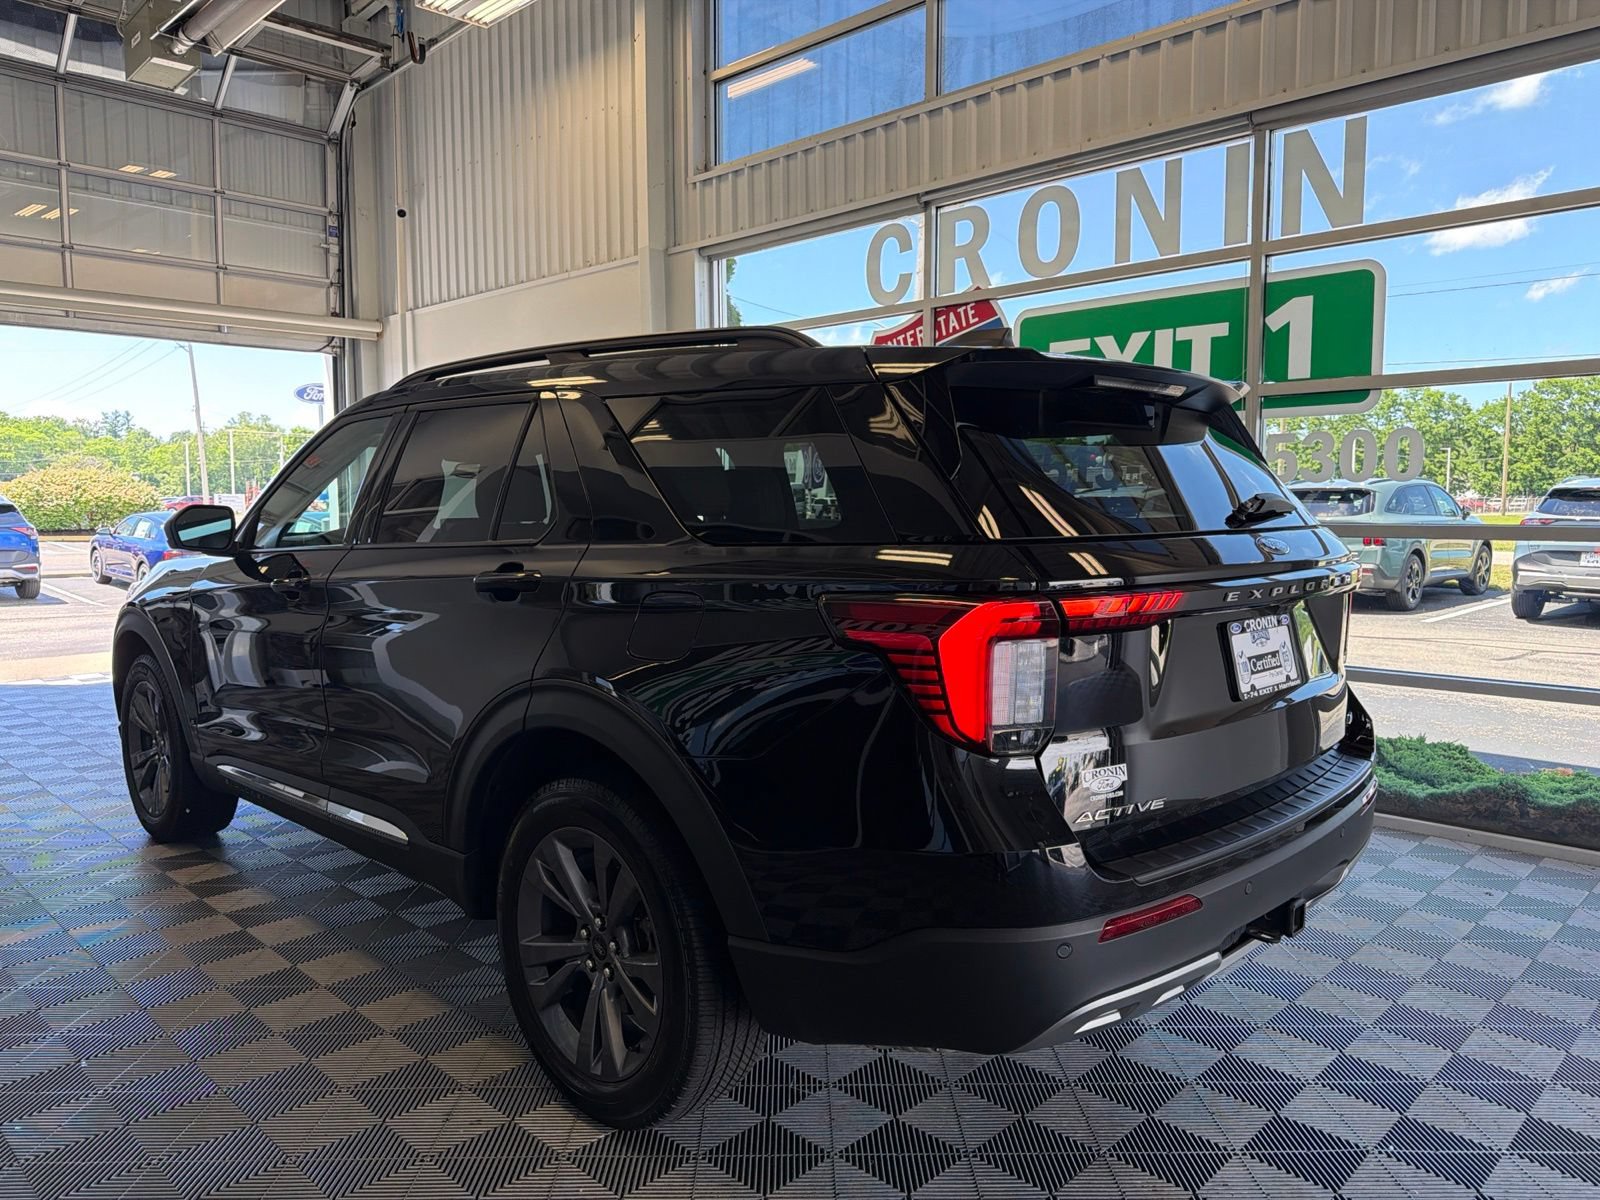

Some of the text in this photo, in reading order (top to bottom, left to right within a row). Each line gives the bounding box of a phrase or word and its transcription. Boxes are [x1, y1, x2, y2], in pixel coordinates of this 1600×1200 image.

[866, 117, 1368, 305] CRONIN
[1264, 295, 1314, 380] 1
[1264, 426, 1425, 483] 5300
[1226, 574, 1351, 602] EXPLORER
[1243, 614, 1278, 632] CRONIN
[1250, 652, 1281, 672] Certified
[1259, 686, 1273, 696] EXIT
[1084, 766, 1126, 782] CRONIN
[1096, 778, 1115, 791] Ford
[1073, 797, 1168, 824] ACTIVE
